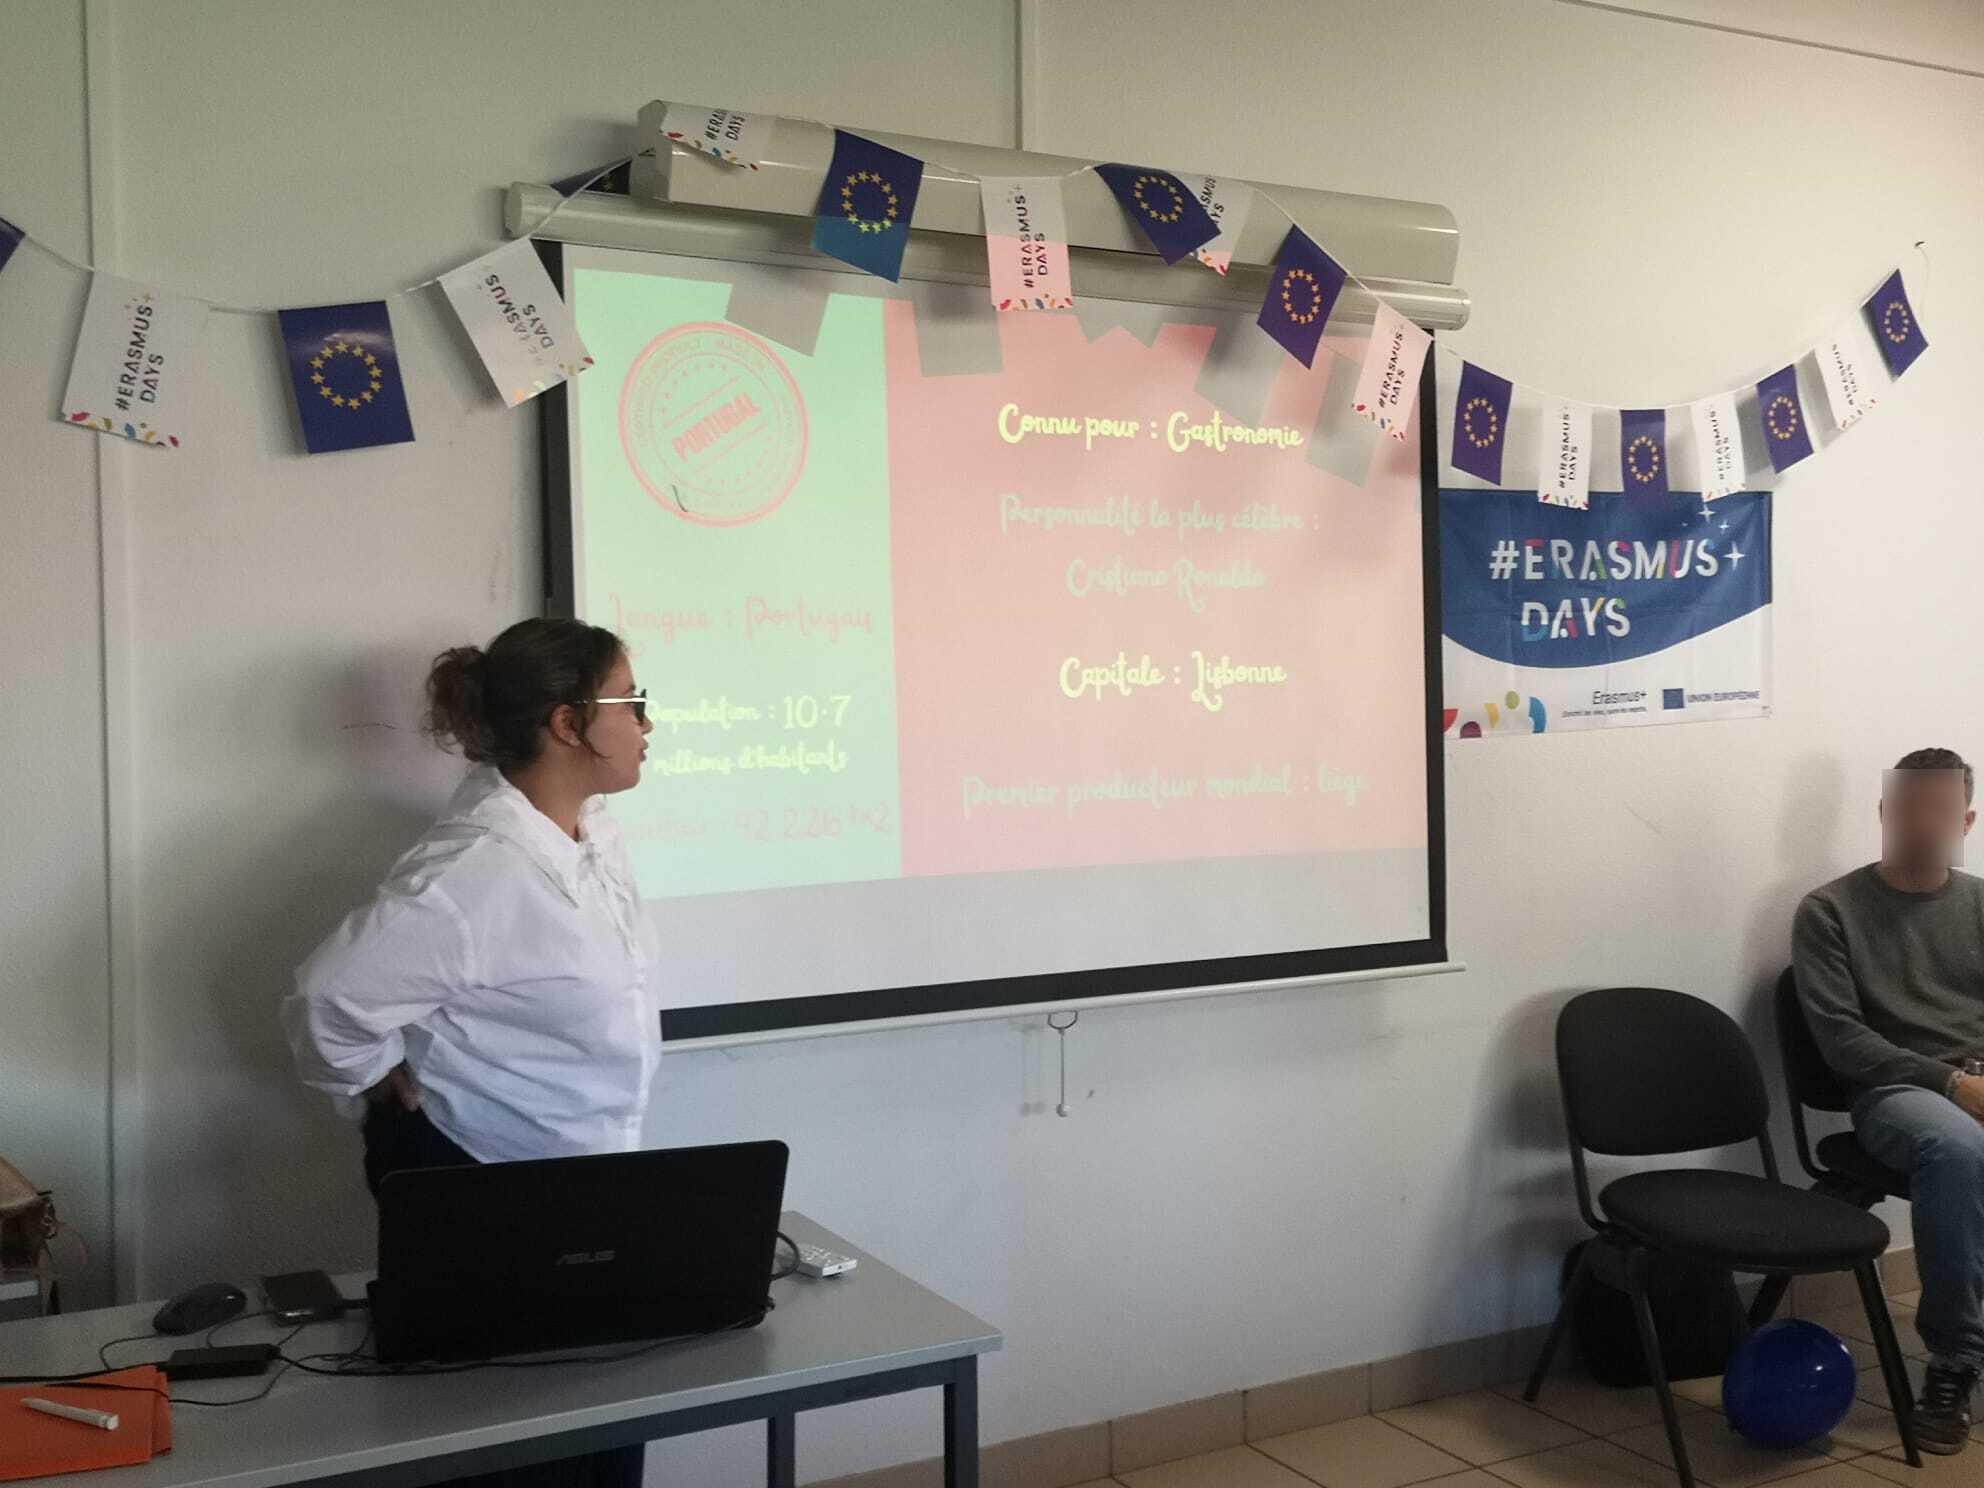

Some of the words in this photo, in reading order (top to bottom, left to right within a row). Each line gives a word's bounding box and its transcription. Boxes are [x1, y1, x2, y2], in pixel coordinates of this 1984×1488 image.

[1014, 194, 1034, 288] #ERASMUS
[1034, 232, 1048, 276] DAYS
[485, 273, 544, 366] ASMUS
[522, 303, 555, 350] DAYS
[115, 304, 153, 412] #ERASMUS
[139, 353, 164, 404] DAYS
[999, 403, 1081, 443] Connu
[1084, 415, 1140, 450] pour
[1167, 411, 1304, 453] Gastronomie
[1489, 537, 1719, 581] #ERASMUS
[1521, 596, 1631, 643] DAYS
[1059, 651, 1166, 700] Capitale
[1190, 650, 1288, 712] Lisbonne
[556, 1249, 616, 1266] ASUS
